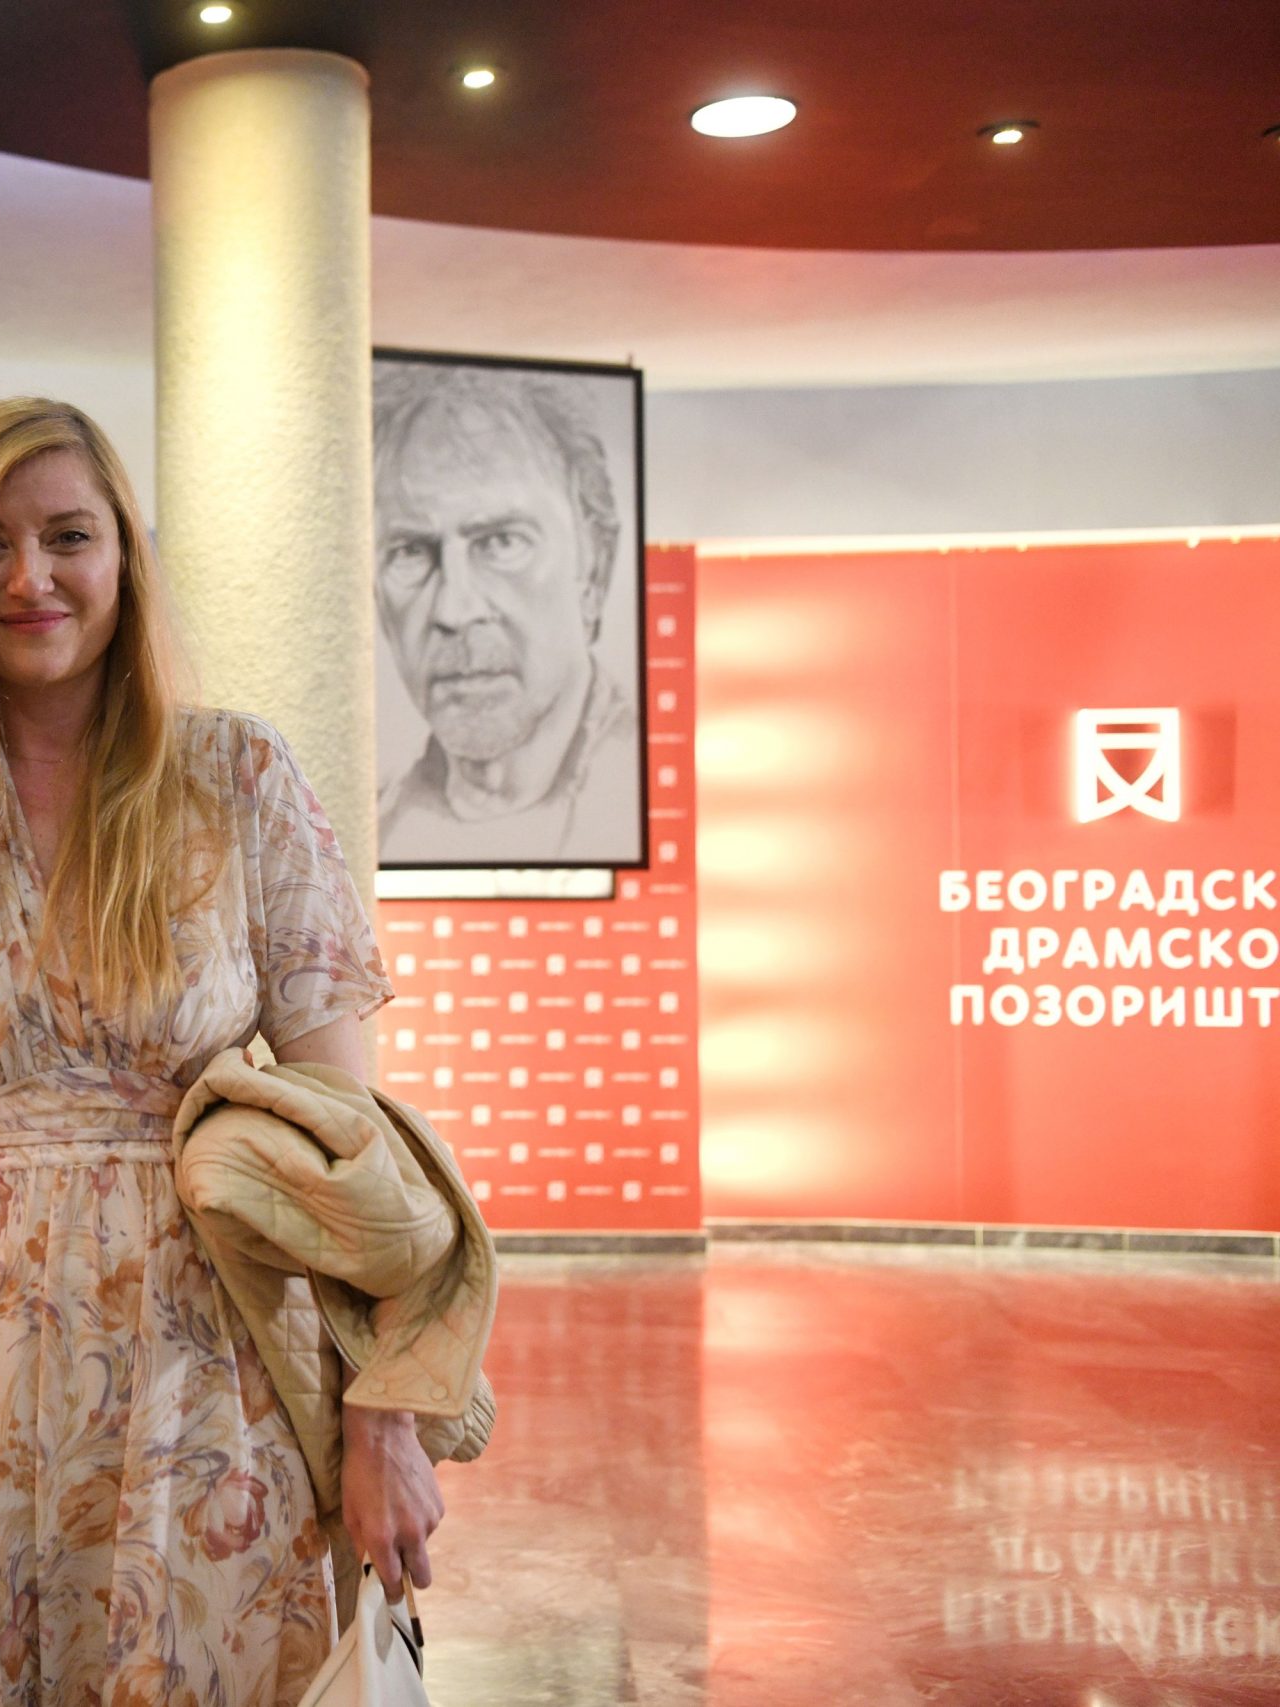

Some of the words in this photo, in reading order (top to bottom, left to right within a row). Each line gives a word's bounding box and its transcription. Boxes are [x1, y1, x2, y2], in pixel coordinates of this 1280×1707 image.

[938, 868, 1277, 917] БЕОГРАДСК
[982, 927, 1279, 975] ДРАМСКО
[949, 984, 1280, 1027] ПОЗОРИШТ
